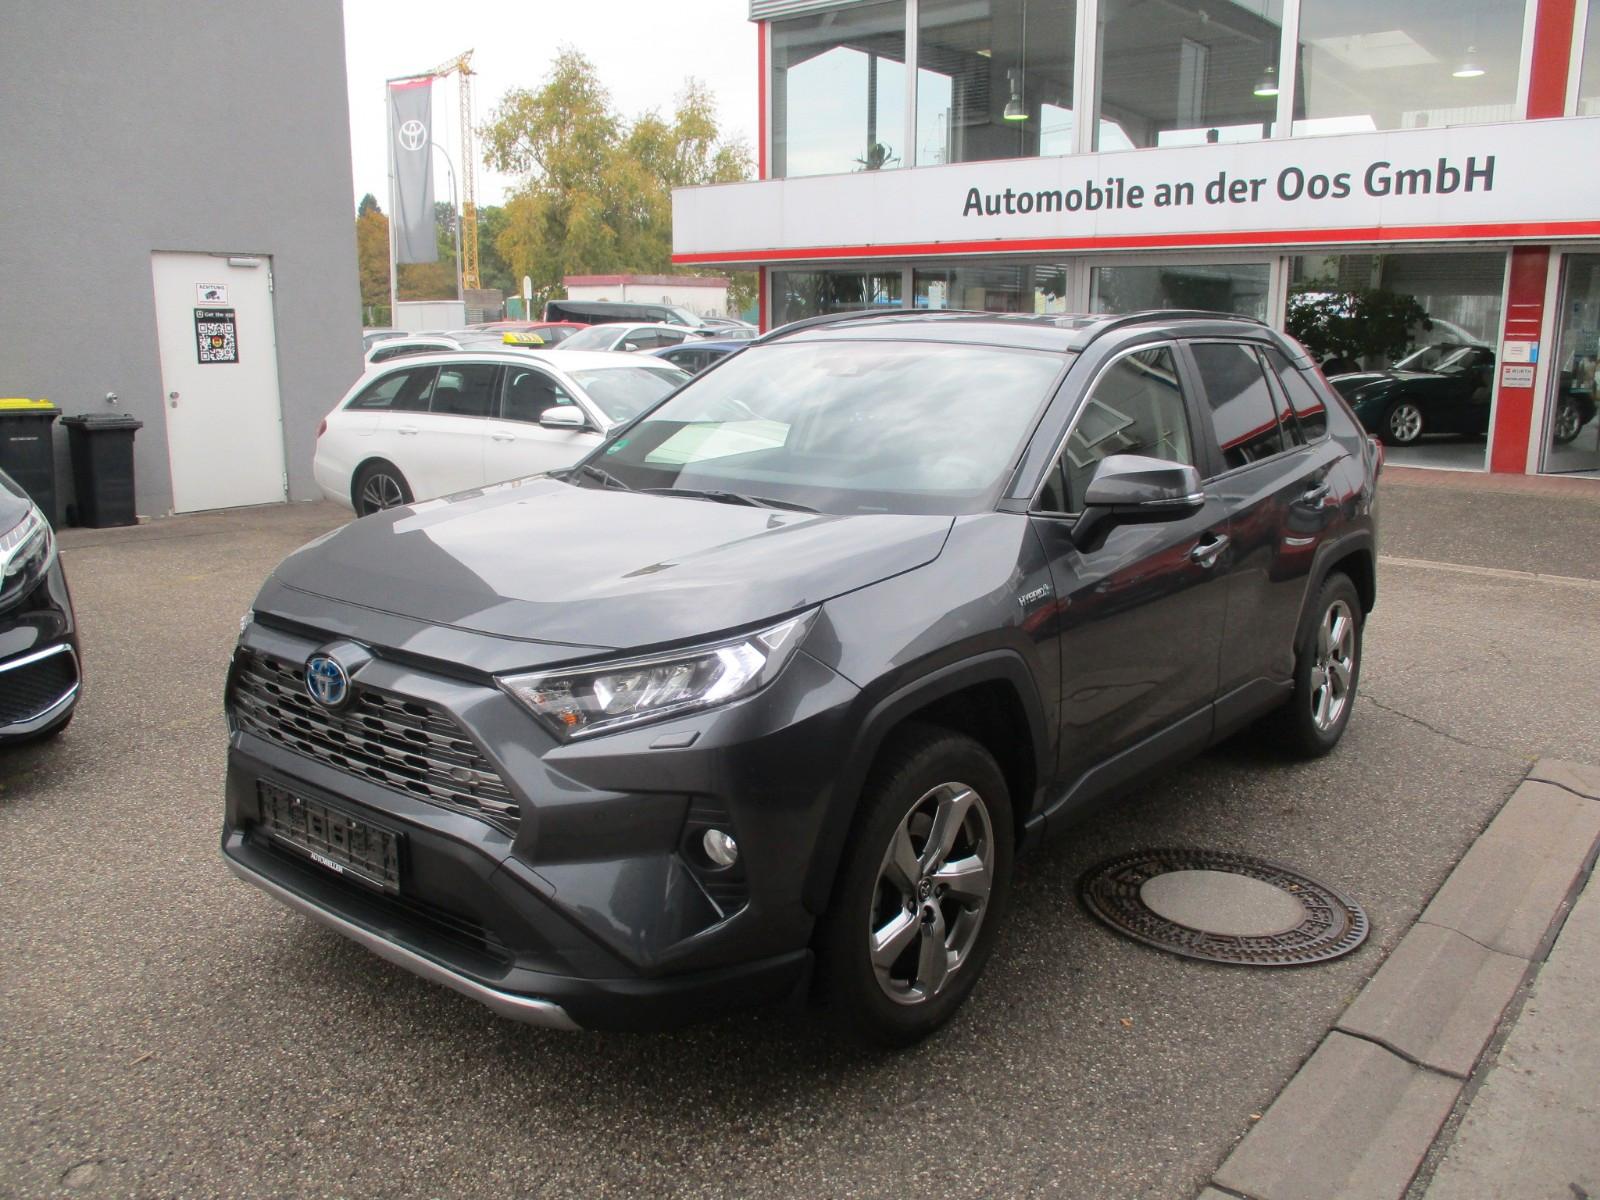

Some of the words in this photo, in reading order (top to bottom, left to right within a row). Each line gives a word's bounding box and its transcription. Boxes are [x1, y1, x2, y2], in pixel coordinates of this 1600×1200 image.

[962, 177, 1145, 217] Automobile
[1153, 181, 1194, 207] an
[1204, 171, 1267, 205] der
[1276, 166, 1351, 202] Oos
[1363, 155, 1496, 197] GmbH
